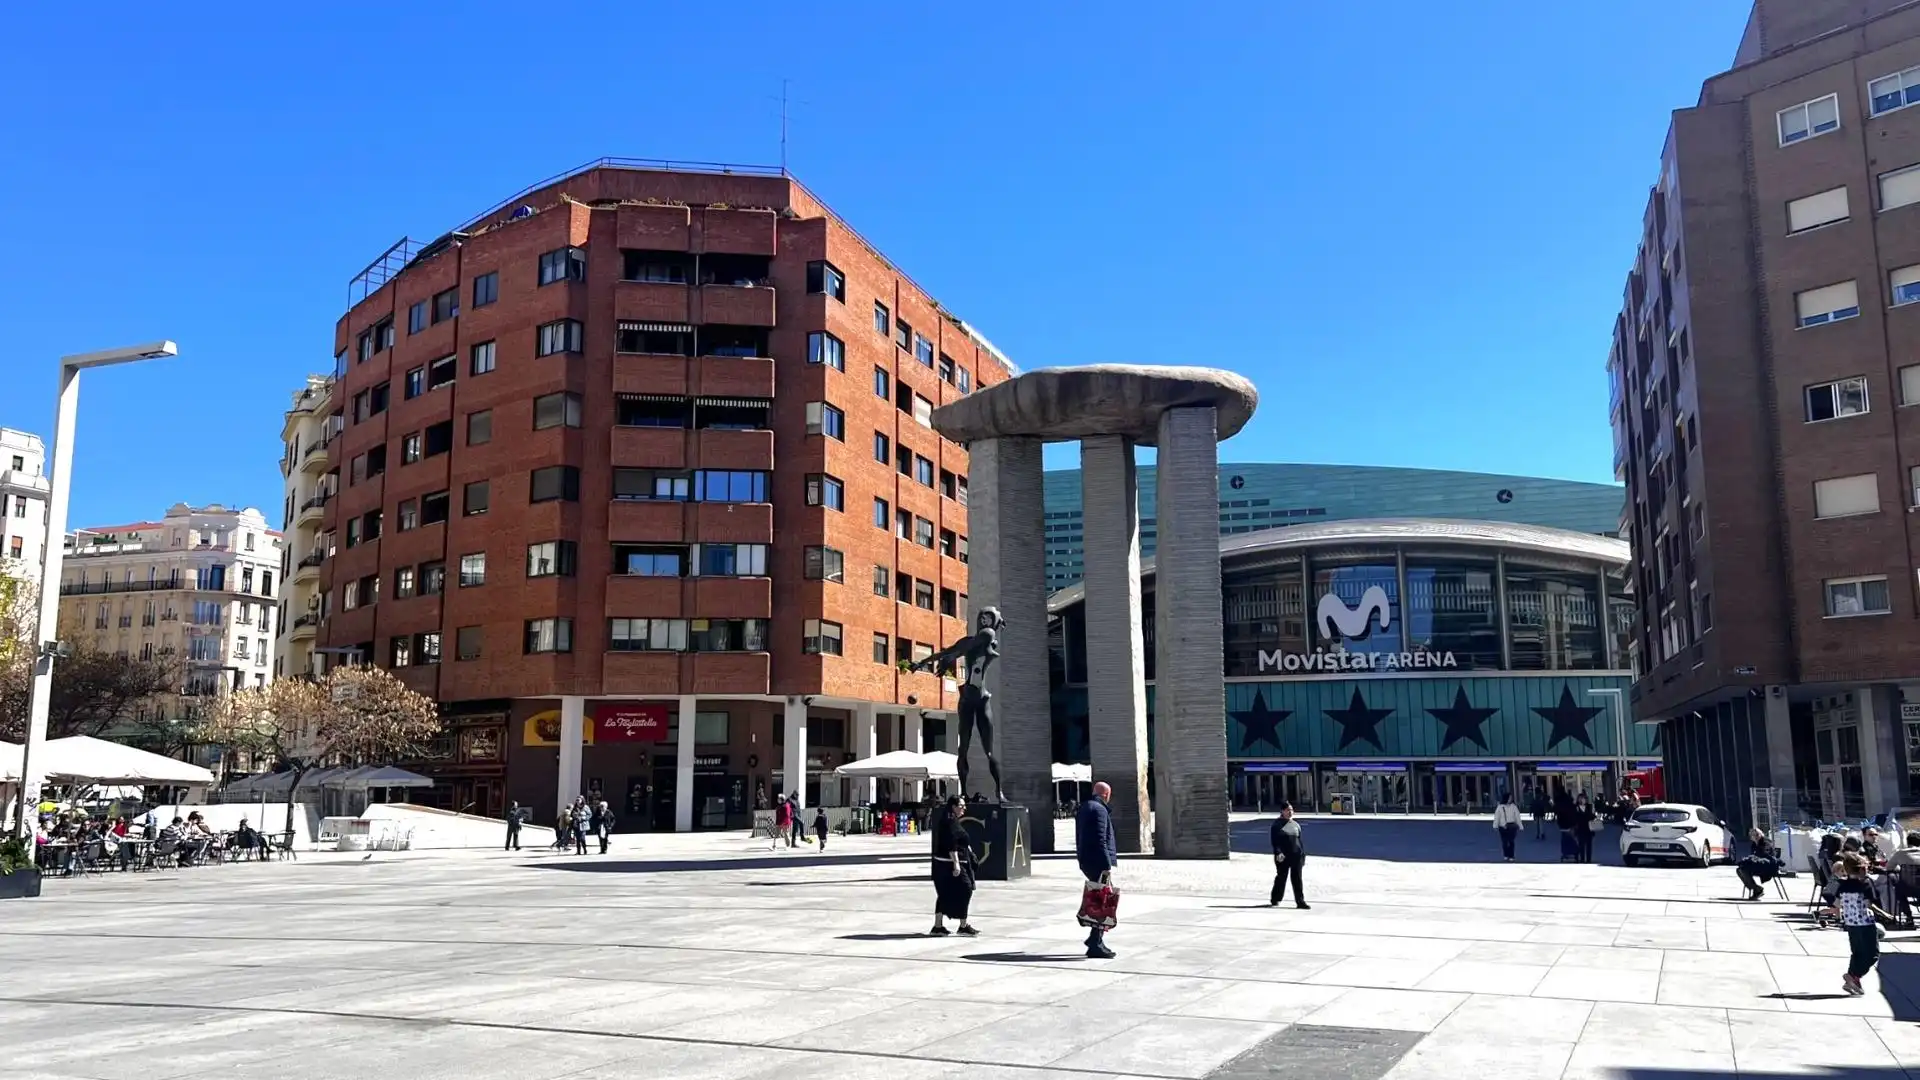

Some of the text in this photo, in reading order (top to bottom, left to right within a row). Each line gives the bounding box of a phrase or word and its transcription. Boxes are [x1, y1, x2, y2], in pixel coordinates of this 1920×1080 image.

[1258, 647, 1457, 672] Movistar ARENA
[1011, 818, 1026, 868] A
